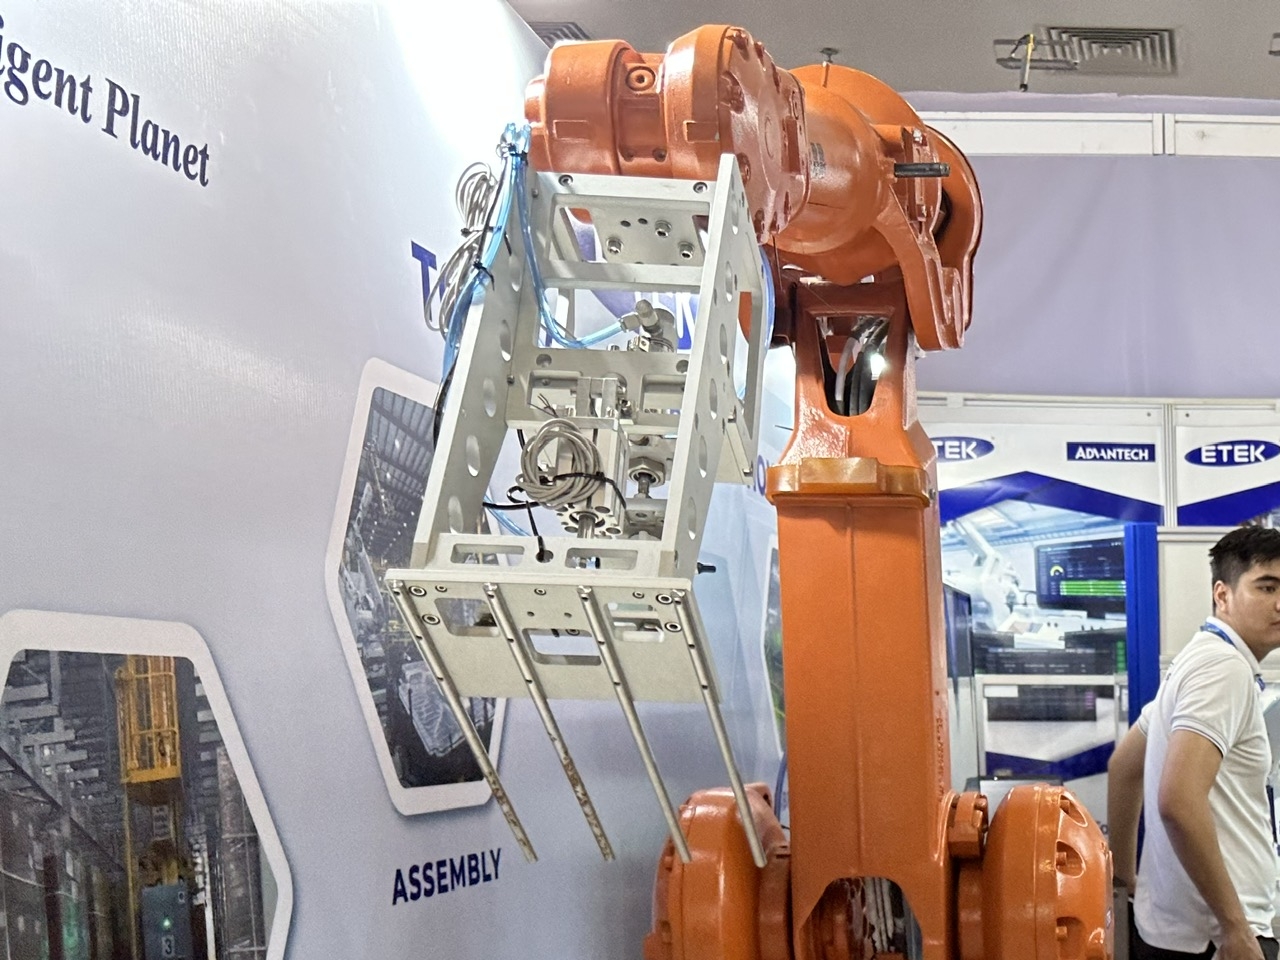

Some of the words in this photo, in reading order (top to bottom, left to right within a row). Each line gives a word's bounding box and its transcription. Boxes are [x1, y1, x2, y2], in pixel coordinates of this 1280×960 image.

[101, 77, 209, 187] Planet
[1075, 446, 1149, 460] ADVANTECH
[1201, 444, 1266, 463] ETEK
[392, 847, 501, 905] ASSEMBLY
